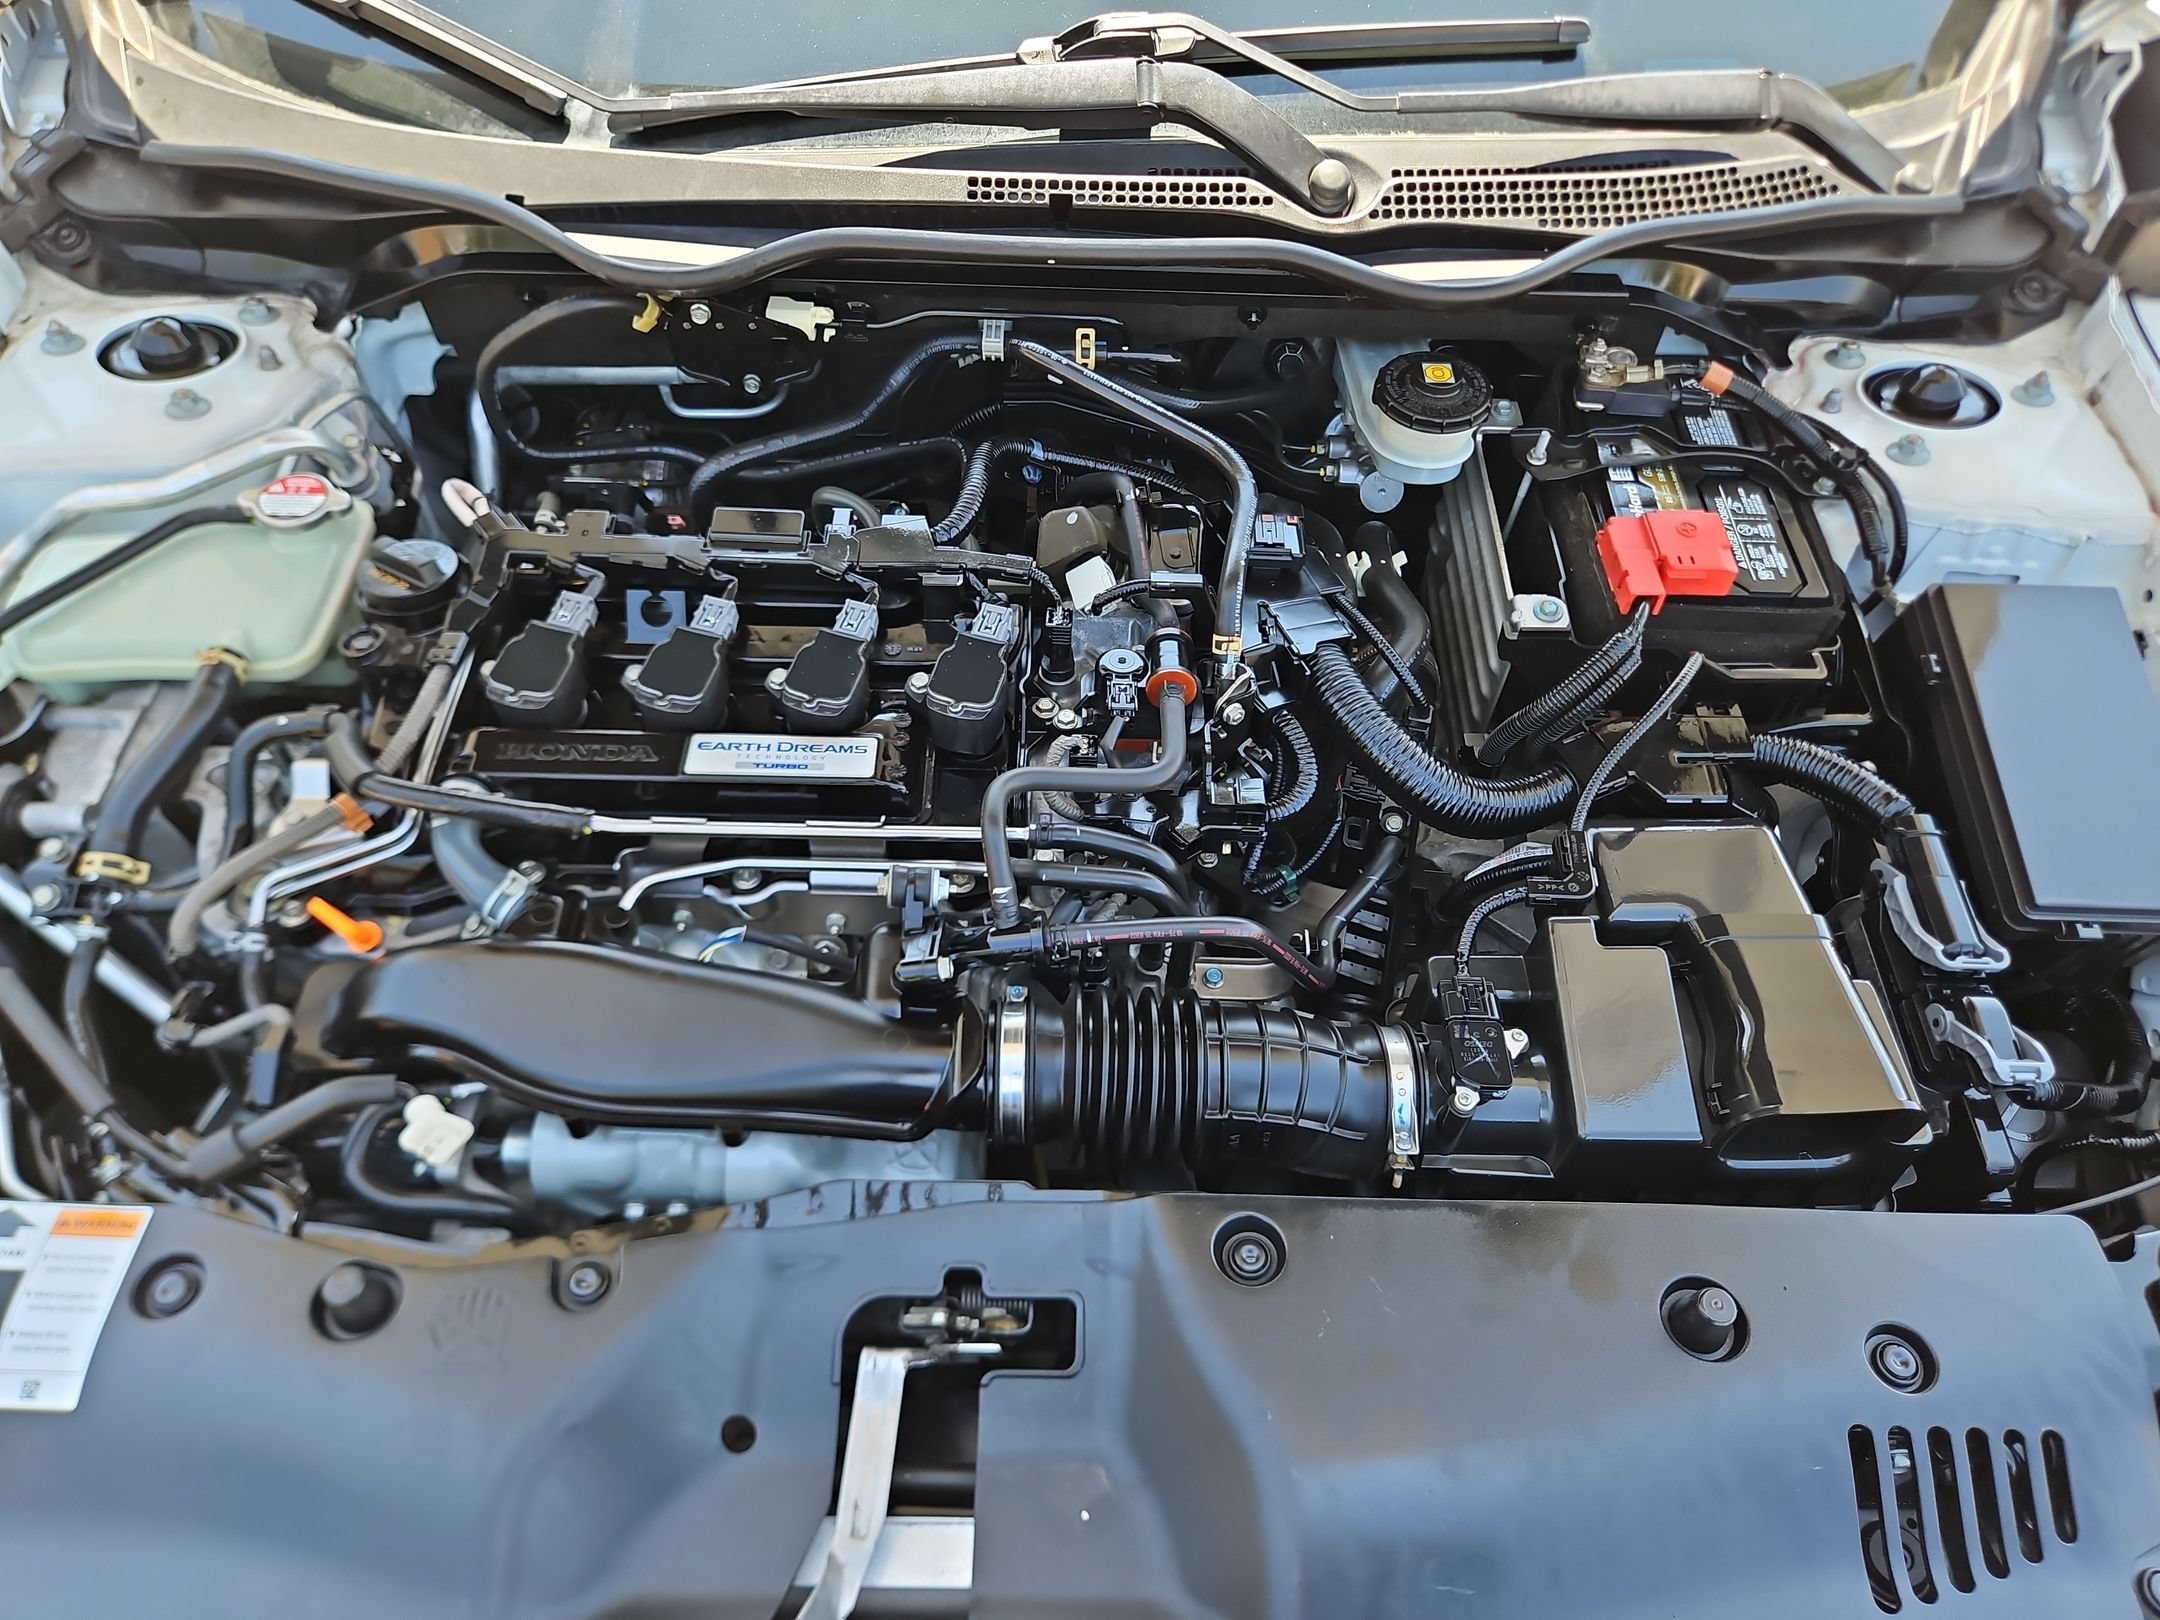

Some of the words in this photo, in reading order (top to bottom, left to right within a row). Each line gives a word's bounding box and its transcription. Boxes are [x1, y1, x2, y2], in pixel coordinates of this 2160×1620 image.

[1714, 497, 1732, 525] POISON
[1726, 530, 1745, 561] DANGER
[496, 742, 660, 763] HONDA
[697, 741, 771, 752] EARTH
[777, 741, 868, 754] DREAMS
[737, 753, 826, 761] TECHNOLOGY
[752, 762, 809, 770] TURBO
